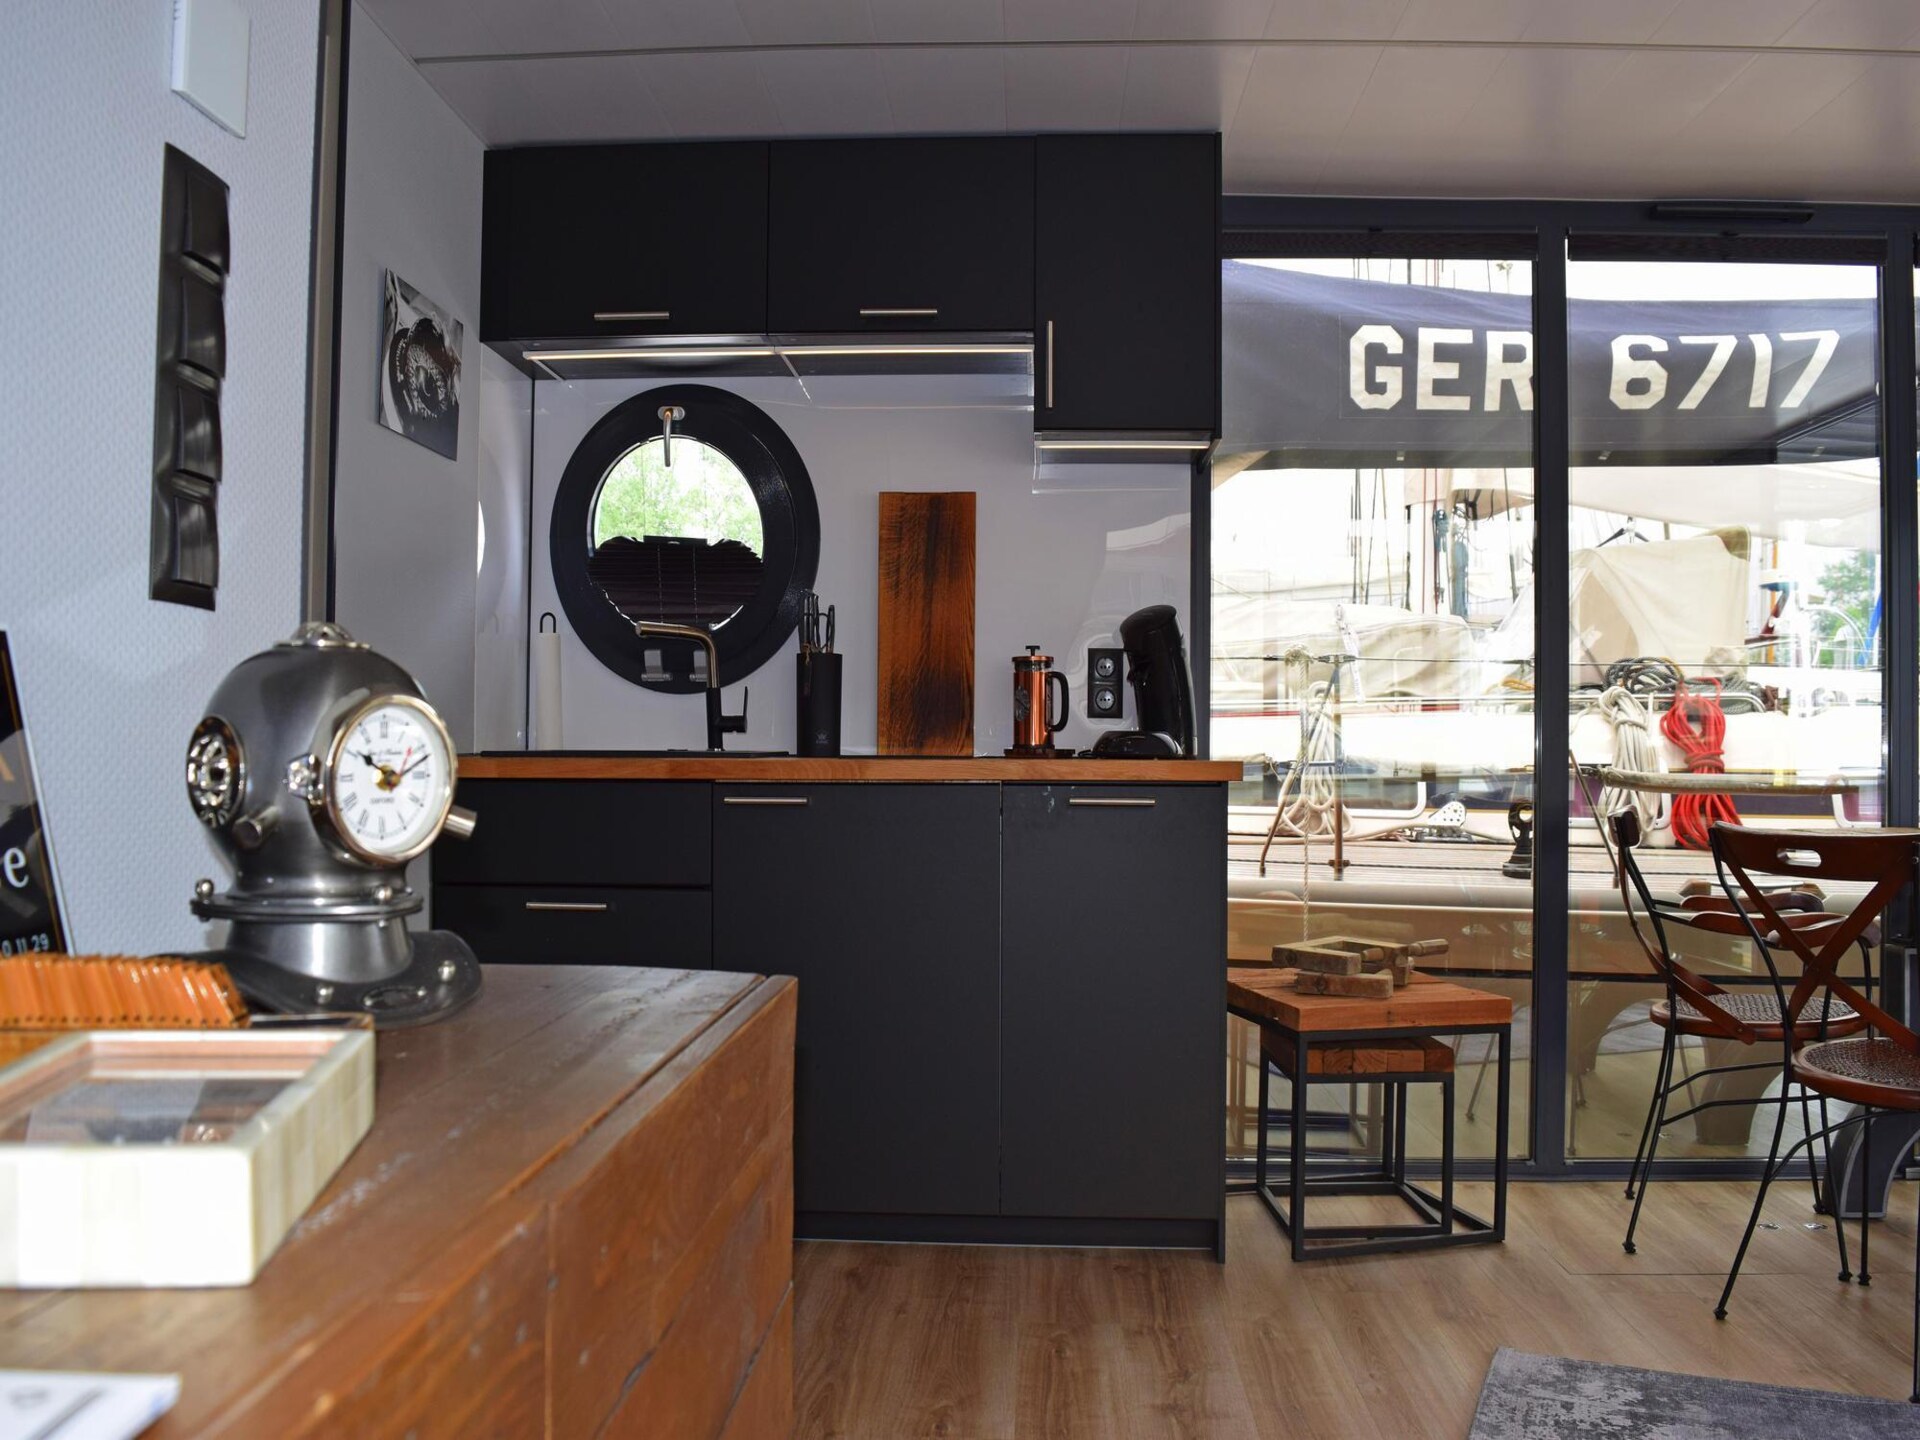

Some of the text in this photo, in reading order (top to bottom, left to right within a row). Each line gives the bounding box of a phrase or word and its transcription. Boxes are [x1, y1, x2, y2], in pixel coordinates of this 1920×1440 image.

[1349, 324, 1841, 411] GER 6717
[31, 932, 50, 953] 29
